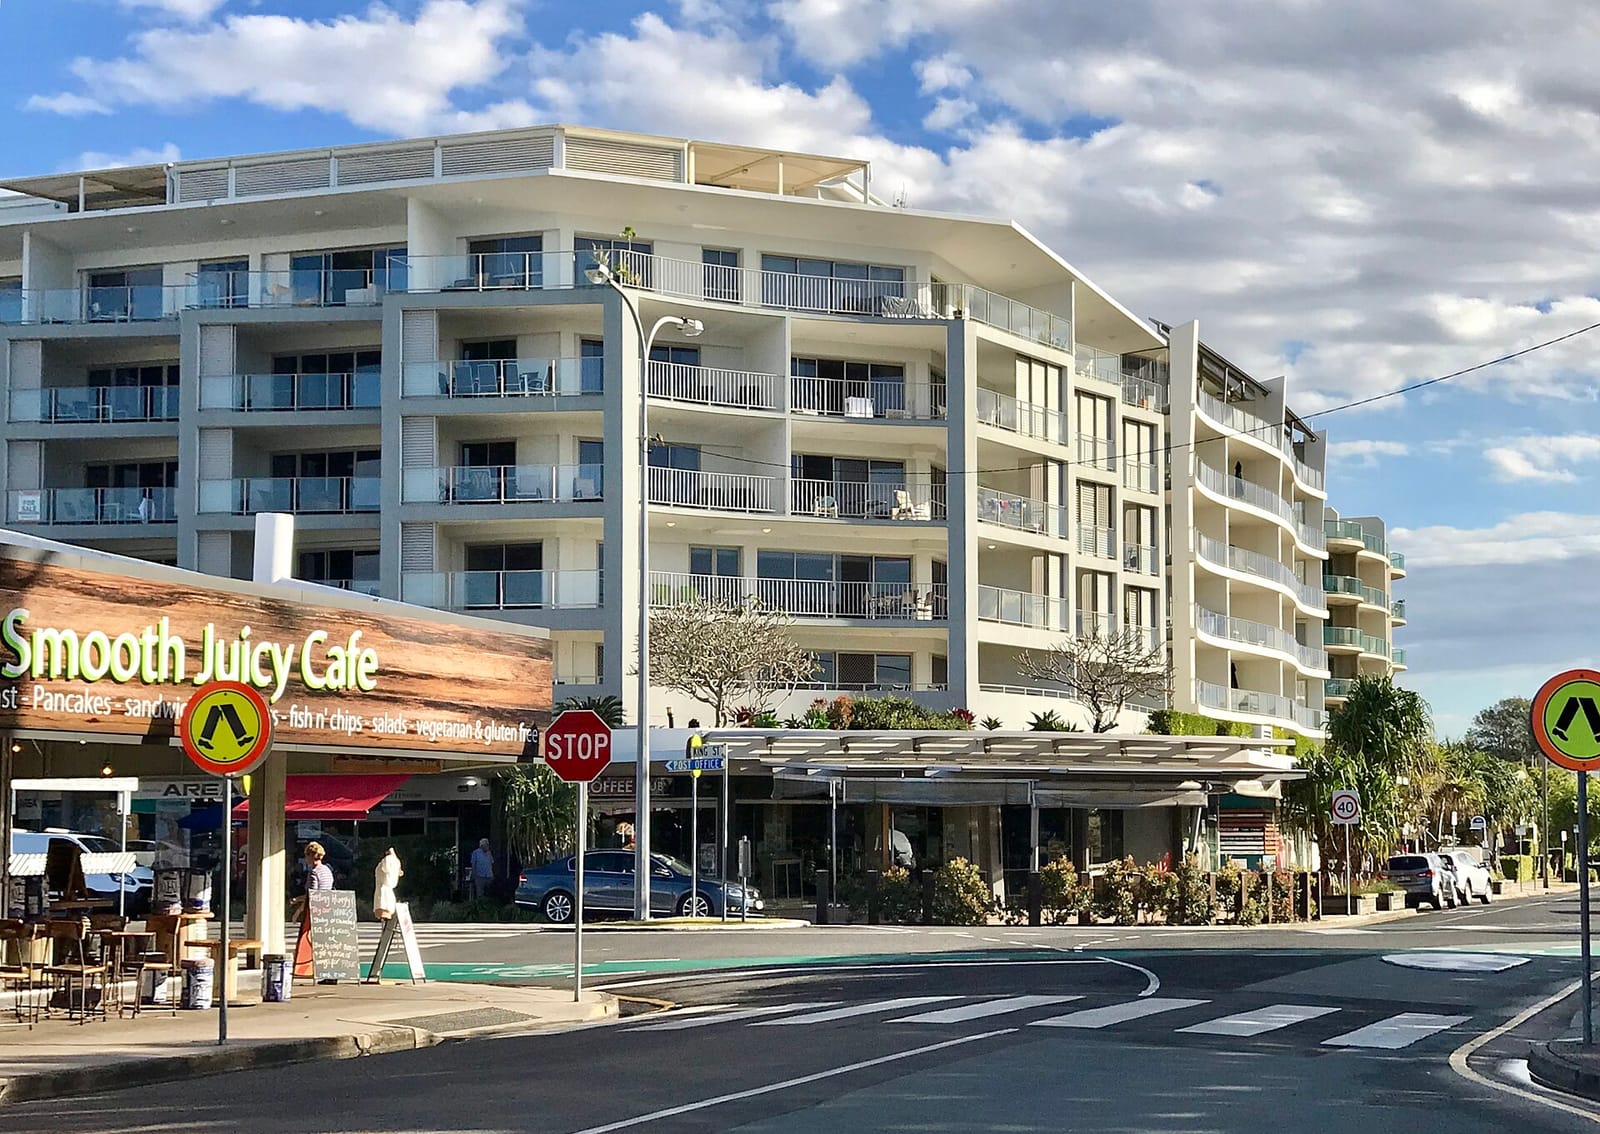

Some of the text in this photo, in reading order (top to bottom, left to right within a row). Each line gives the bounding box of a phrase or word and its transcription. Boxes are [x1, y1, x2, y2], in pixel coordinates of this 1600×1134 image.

[2, 608, 379, 704] Smooth Juicy Cafe
[1, 686, 18, 709] st
[33, 685, 112, 715] Pancakes
[124, 694, 188, 720] sandwic
[289, 704, 313, 729] fish
[329, 708, 363, 737] chips
[371, 712, 408, 735] salads
[415, 719, 472, 742] vegetarian
[474, 719, 483, 740] &
[484, 720, 517, 746] gluten
[519, 722, 539, 743] free
[548, 733, 609, 760] STOP
[673, 758, 720, 770] POST OFFICE
[590, 779, 633, 793] OFFEE
[1337, 801, 1354, 813] 40
